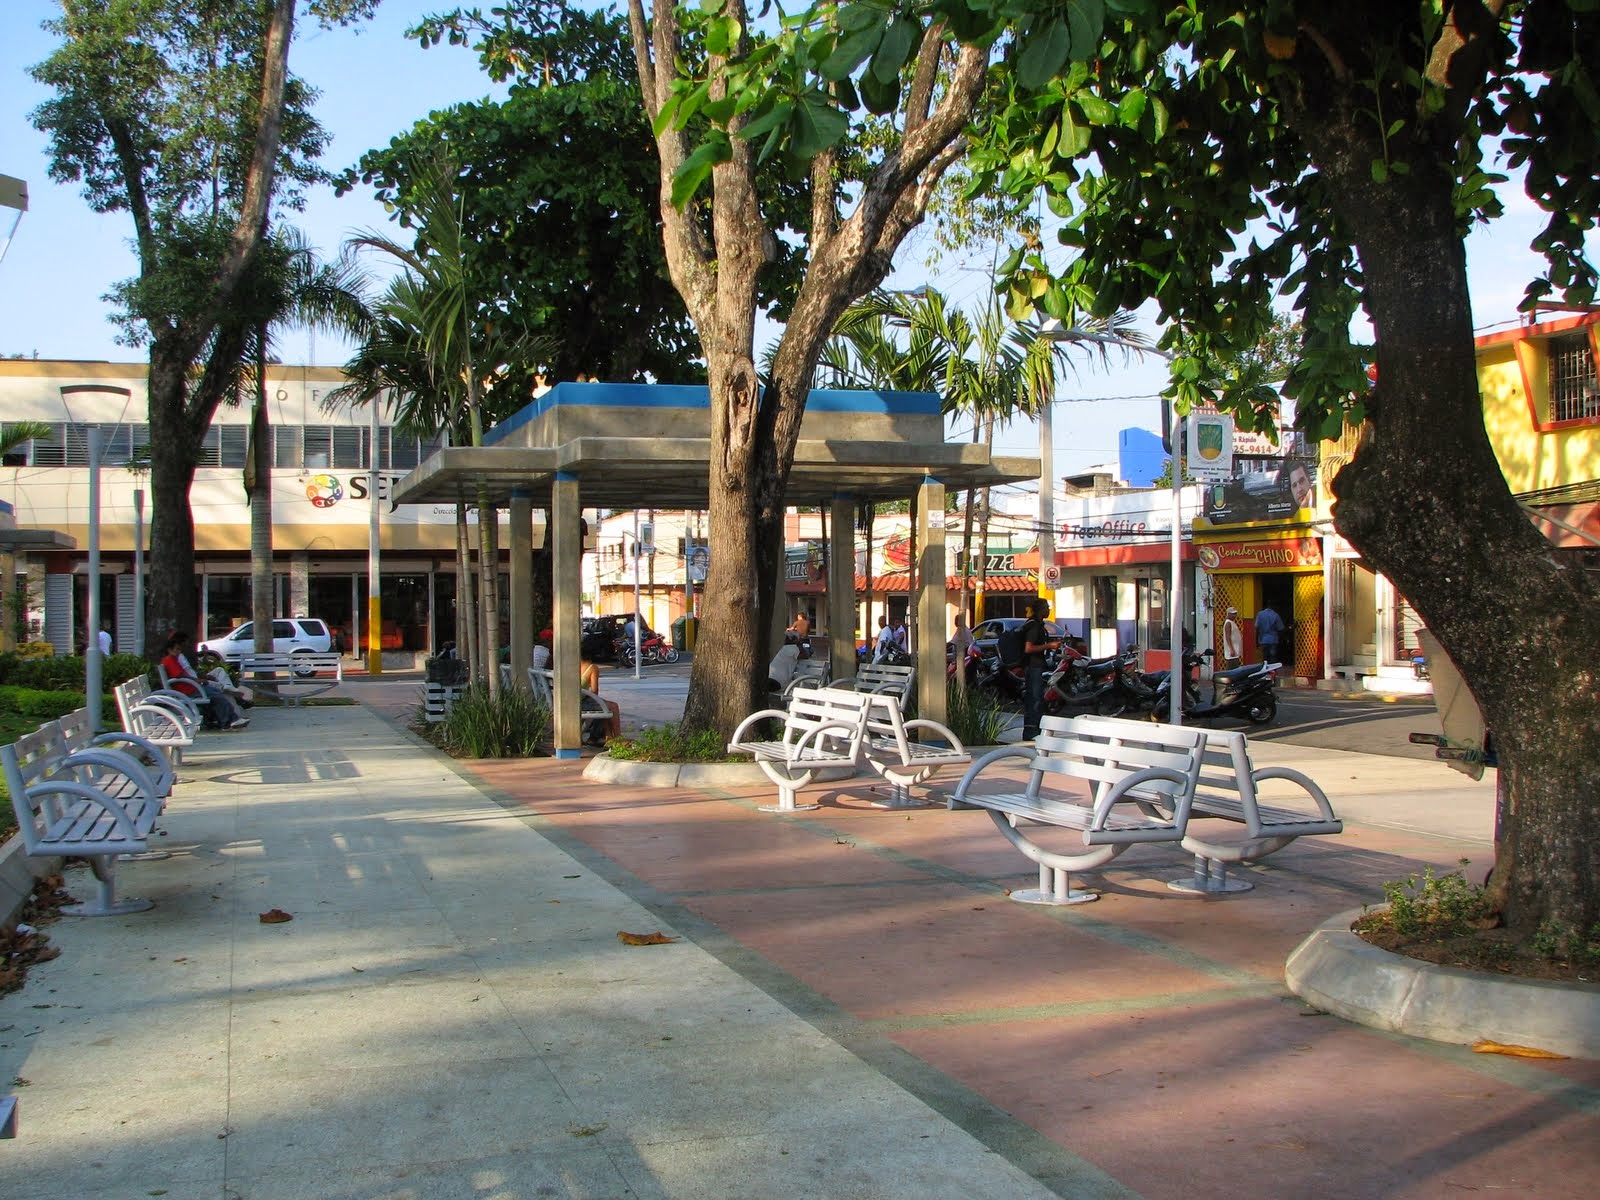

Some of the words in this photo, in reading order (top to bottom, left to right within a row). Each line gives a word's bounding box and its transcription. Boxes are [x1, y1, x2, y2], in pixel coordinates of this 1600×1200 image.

[1231, 445, 1272, 454] 25-9414
[1071, 519, 1146, 541] TecnOffice
[1218, 544, 1256, 559] Comedor
[1255, 548, 1294, 564] CHINO
